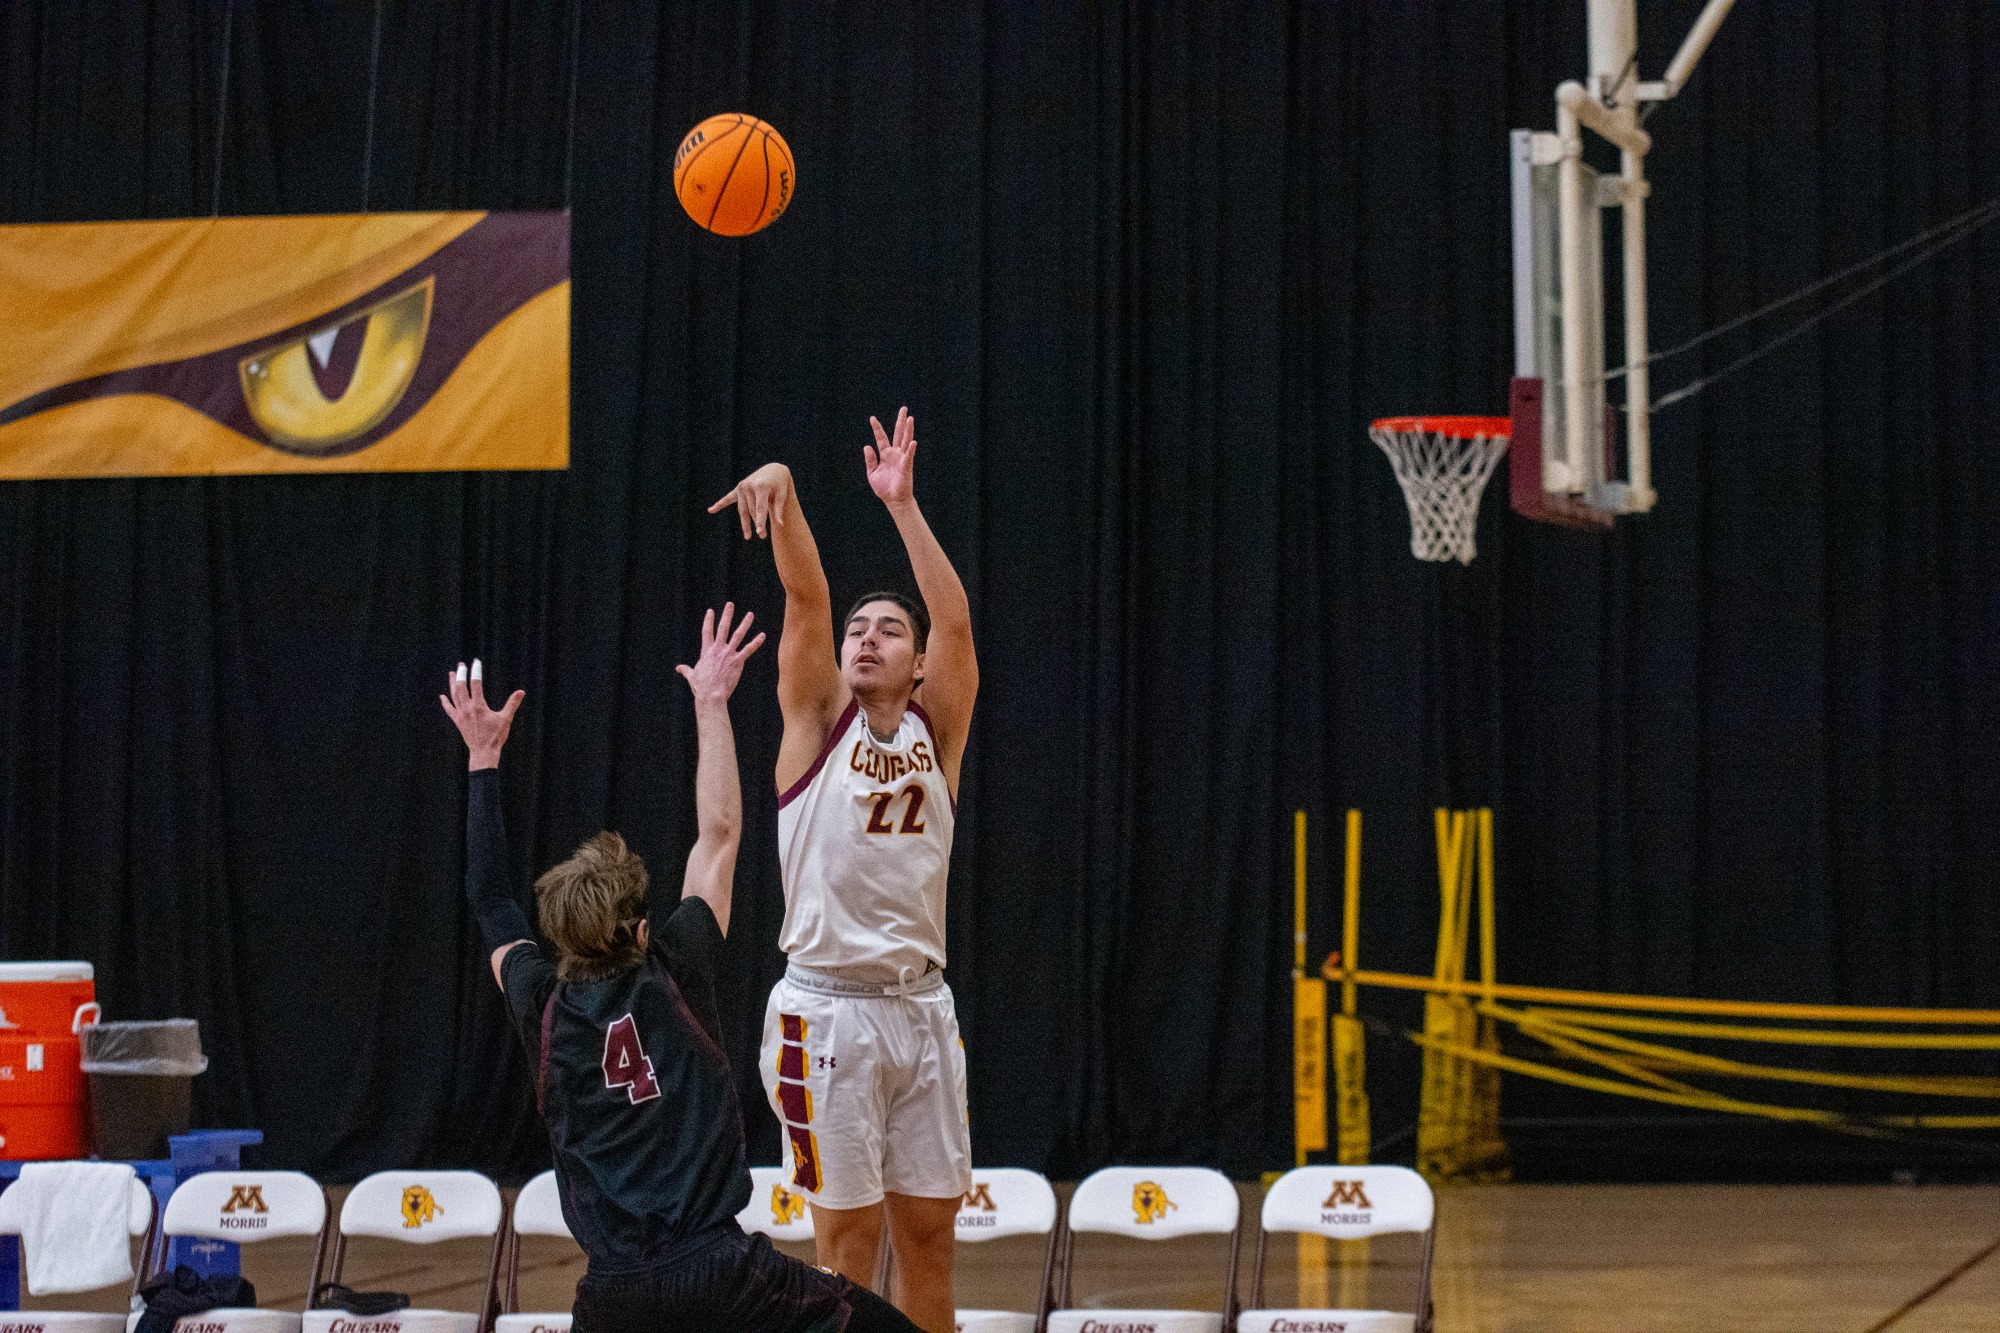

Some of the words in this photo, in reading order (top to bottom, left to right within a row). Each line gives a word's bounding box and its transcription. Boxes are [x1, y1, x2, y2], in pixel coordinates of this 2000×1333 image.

[865, 784, 926, 835] 22
[832, 980, 886, 995] NDER
[602, 1012, 662, 1105] 4
[221, 1185, 269, 1214] M
[1322, 1180, 1372, 1209] M
[219, 1217, 268, 1229] MORRIS
[955, 1215, 997, 1227] ORRIS
[1320, 1213, 1371, 1224] MORRIS
[0, 1323, 46, 1333] GARS
[173, 1322, 228, 1333] UGARS
[329, 1318, 402, 1333] COUGARS
[1269, 1318, 1347, 1333] COUGARS
